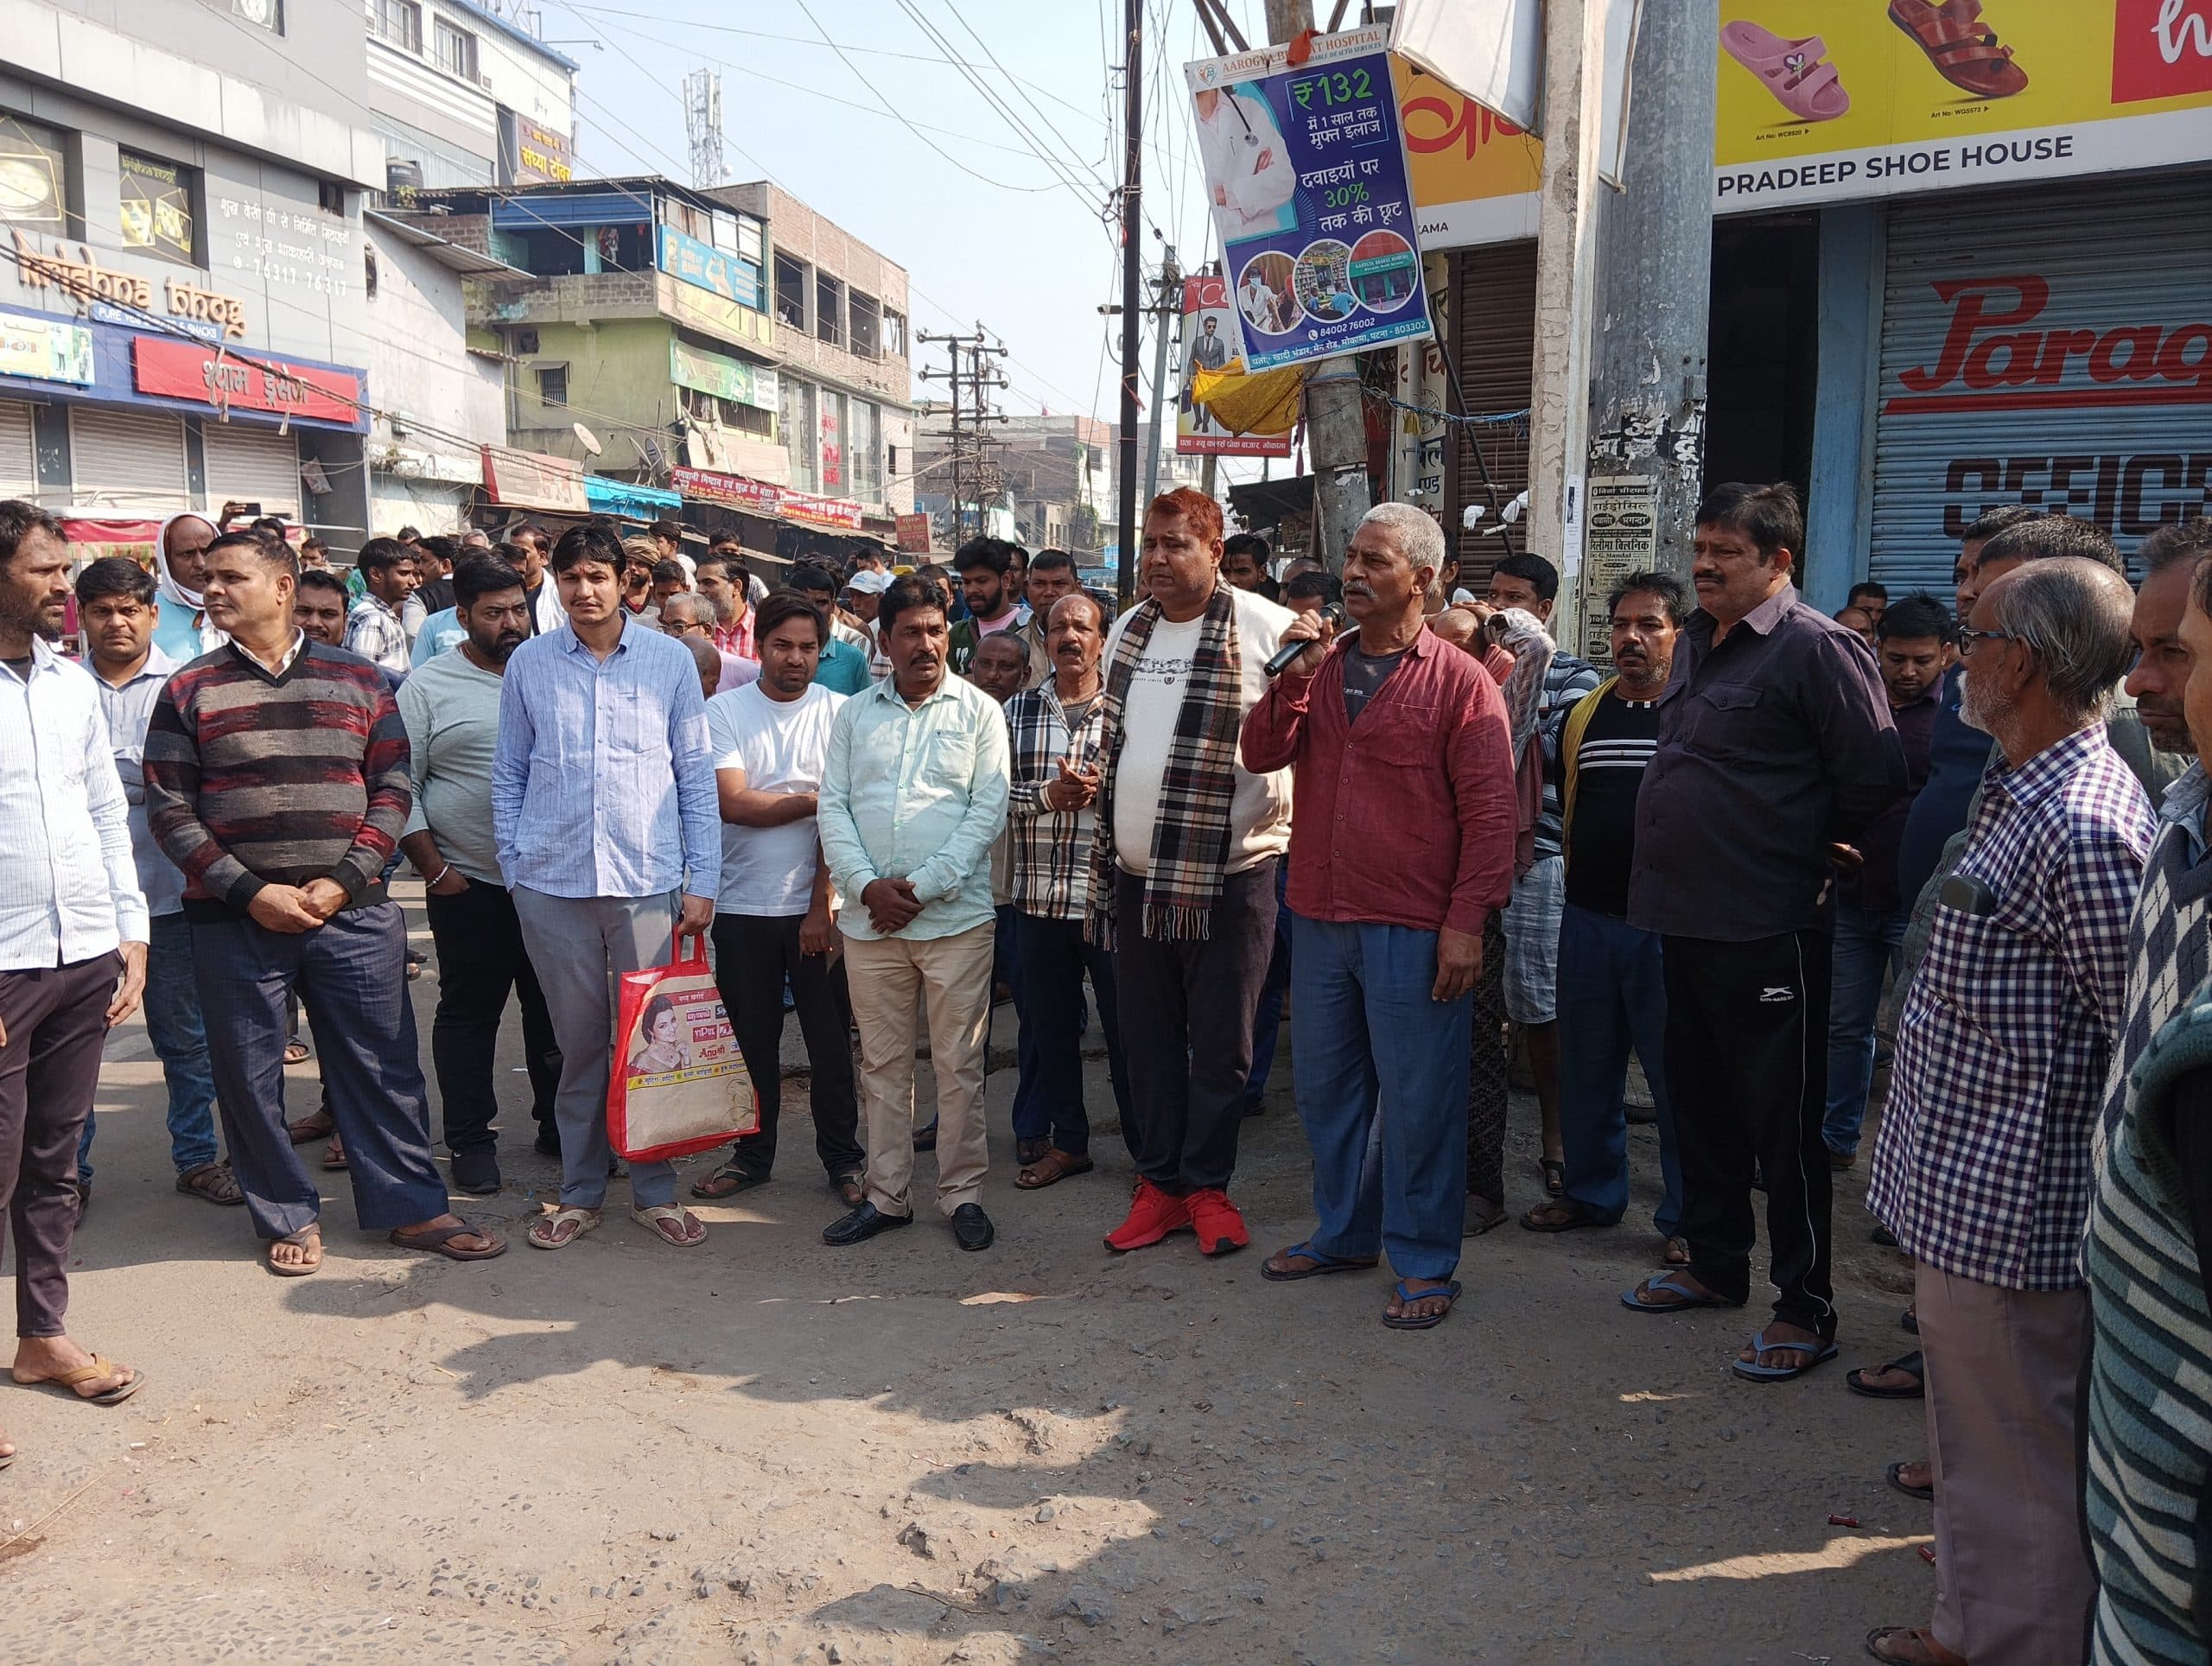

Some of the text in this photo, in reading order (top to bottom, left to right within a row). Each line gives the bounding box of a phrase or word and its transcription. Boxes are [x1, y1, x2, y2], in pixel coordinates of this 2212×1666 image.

[1223, 52, 1274, 73] AAROGYA
[1325, 30, 1381, 50] HOSPITAL
[1306, 106, 1378, 130] में 1 साल तक
[1309, 119, 1381, 150] मुफ्त इलाज
[1300, 158, 1381, 188] दवाइयों पर
[1717, 135, 2074, 197] PRADEEP SHOE HOUSE
[1323, 181, 1370, 209] 30%
[1319, 200, 1402, 232] तक की छूट
[163, 276, 249, 338] bhog
[1319, 317, 1376, 337] 84002 76002
[1370, 329, 1389, 340] पटना
[1395, 321, 1427, 334] 803302
